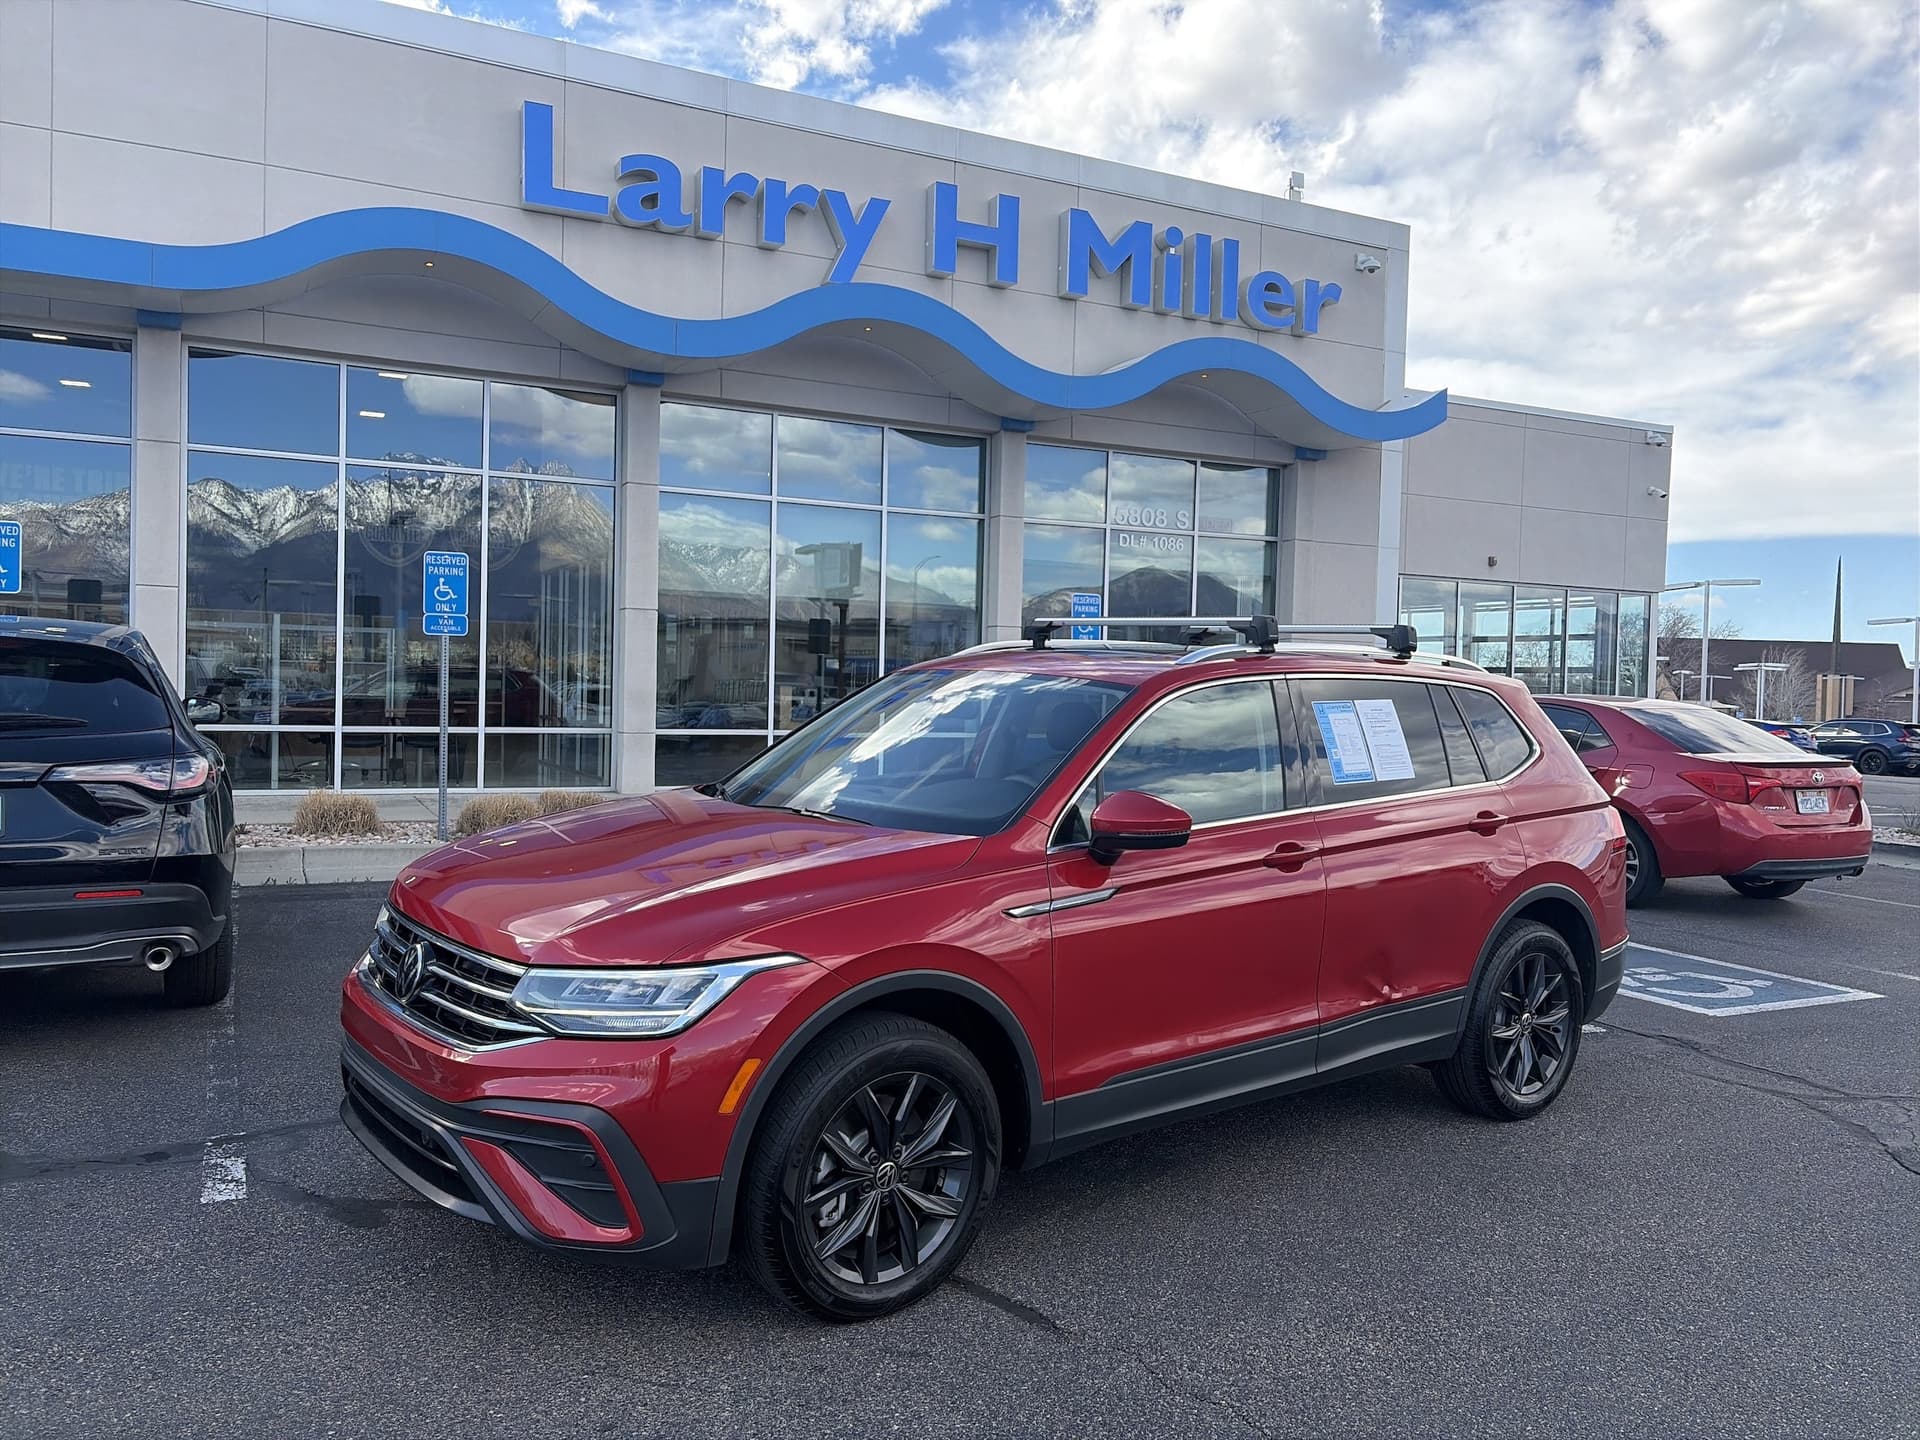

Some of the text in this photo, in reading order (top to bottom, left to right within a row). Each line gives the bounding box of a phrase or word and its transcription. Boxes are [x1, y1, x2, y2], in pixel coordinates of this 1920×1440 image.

[521, 100, 1343, 337] Larry H Miller
[1114, 506, 1167, 528] 5808
[1175, 510, 1189, 529] S
[1119, 533, 1184, 551] DL# 1086
[426, 555, 466, 566] RESERVED
[428, 566, 464, 577] PARKING
[435, 603, 457, 612] ONLY
[438, 617, 454, 626] VAN
